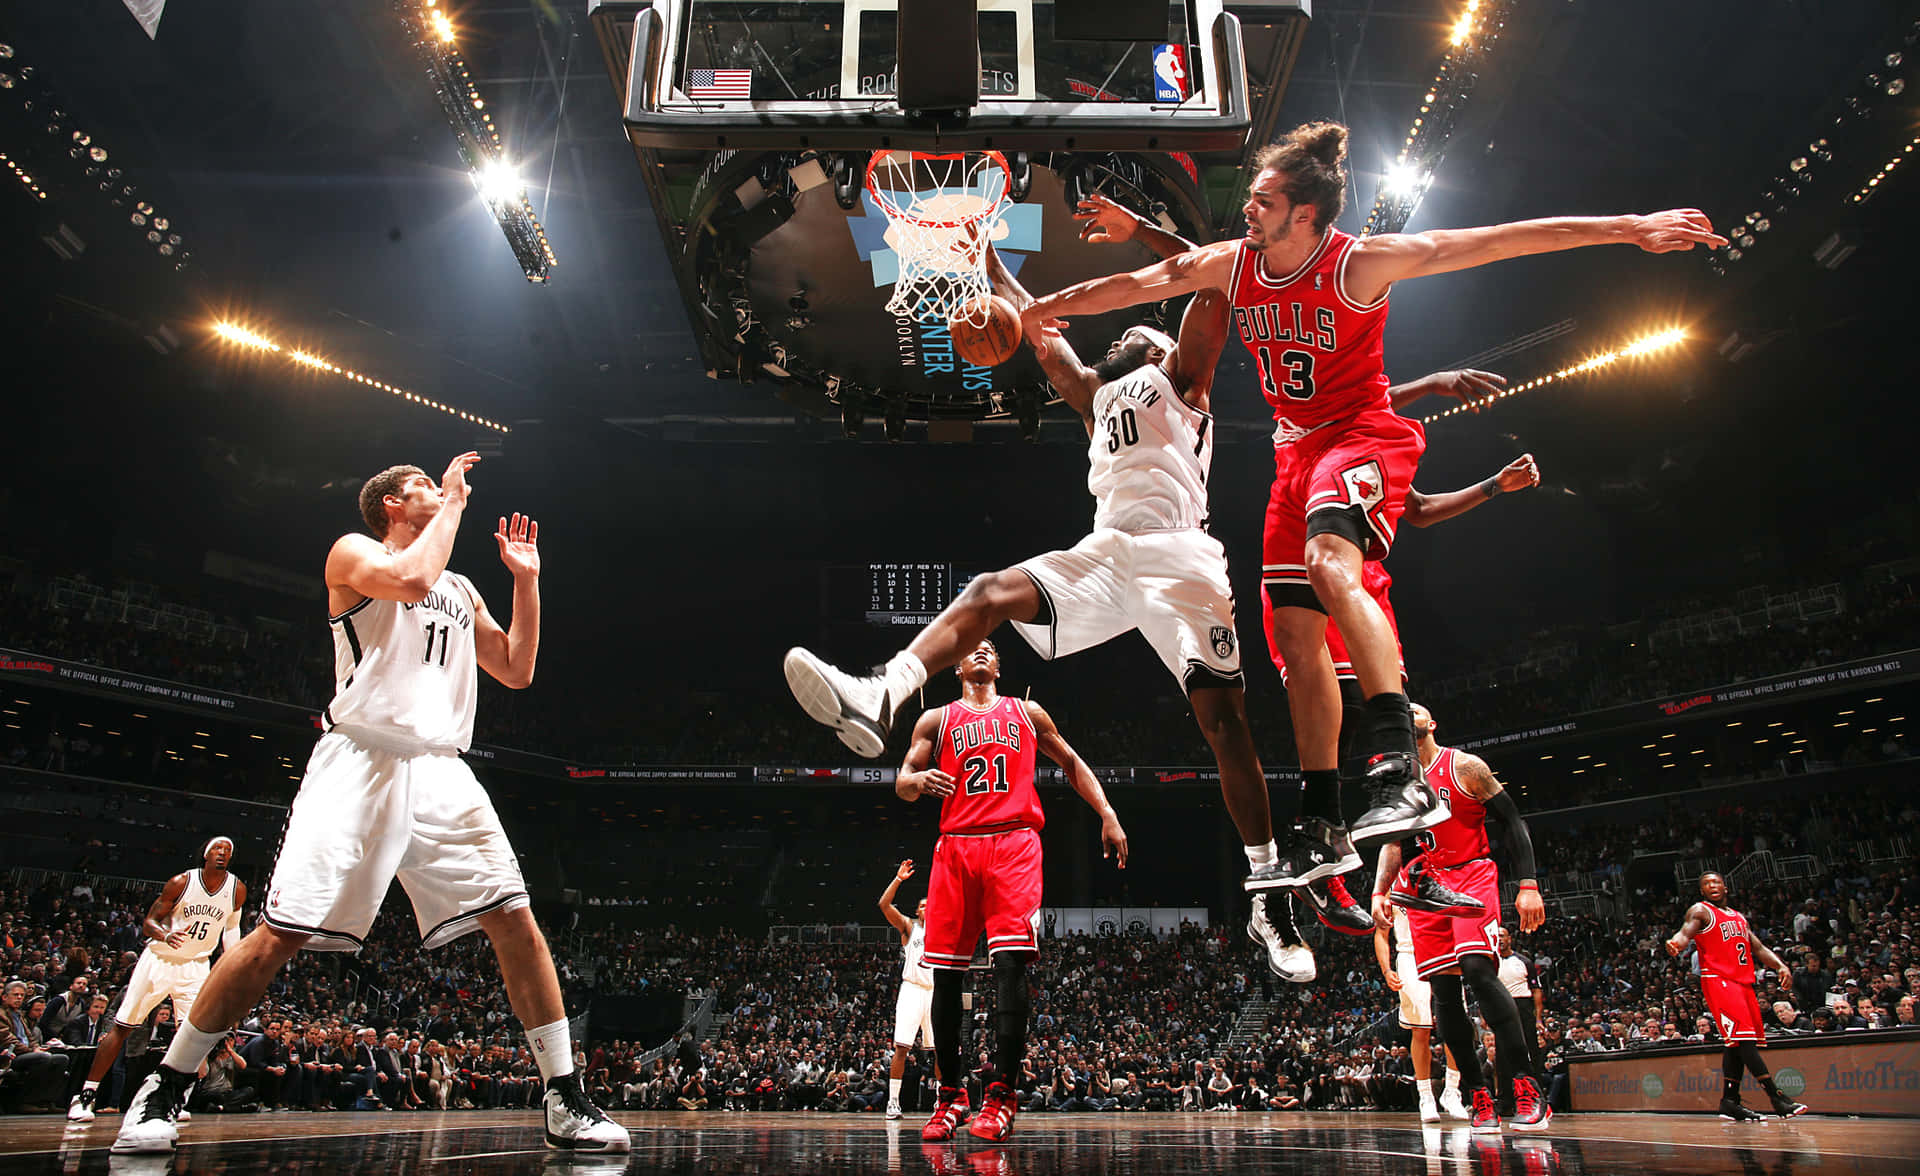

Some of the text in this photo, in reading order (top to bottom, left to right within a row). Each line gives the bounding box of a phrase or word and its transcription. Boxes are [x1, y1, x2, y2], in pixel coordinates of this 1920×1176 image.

[1159, 90, 1178, 99] NBA
[1235, 303, 1336, 352] BULLS
[1258, 347, 1315, 400] 13
[1107, 408, 1139, 454] 30
[891, 615, 916, 624] CHICAGO
[424, 621, 450, 667] 11
[1211, 628, 1235, 646] NETS
[951, 719, 1021, 759] BULLS
[863, 770, 882, 782] 59
[964, 754, 1009, 796] 21
[183, 904, 225, 922] BROOKLYN
[188, 921, 210, 941] 45
[1736, 942, 1748, 966] 2
[1575, 1074, 1640, 1095] AutoTrader
